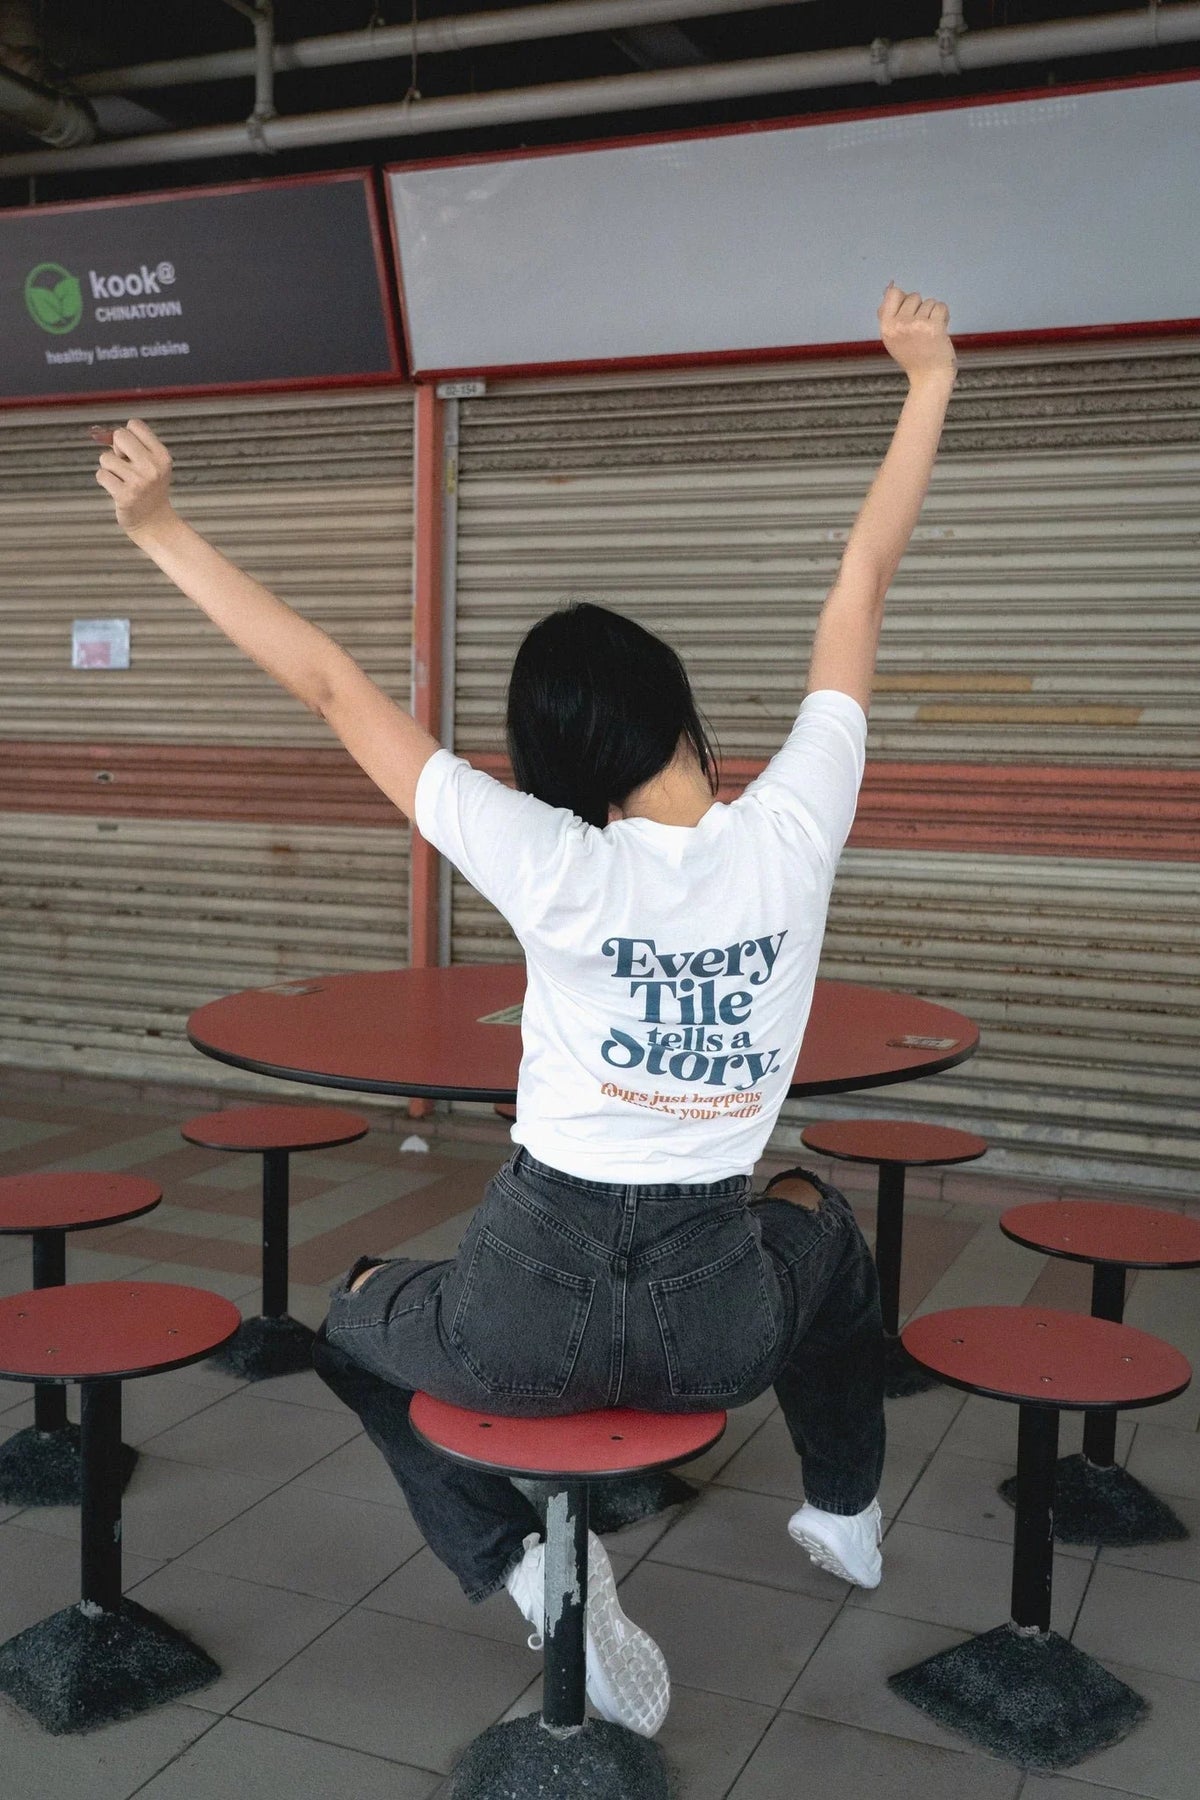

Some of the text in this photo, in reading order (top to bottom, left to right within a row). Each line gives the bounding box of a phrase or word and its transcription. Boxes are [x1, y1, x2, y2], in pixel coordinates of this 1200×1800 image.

[95, 301, 182, 322] CHINATOWN
[45, 340, 190, 365] healthy Indian cuisine
[601, 929, 788, 985] Every
[630, 978, 753, 1026] Tile
[647, 1026, 752, 1052] tells a
[650, 1090, 688, 1106] just
[692, 1091, 762, 1108] happens
[679, 1107, 720, 1120] your
